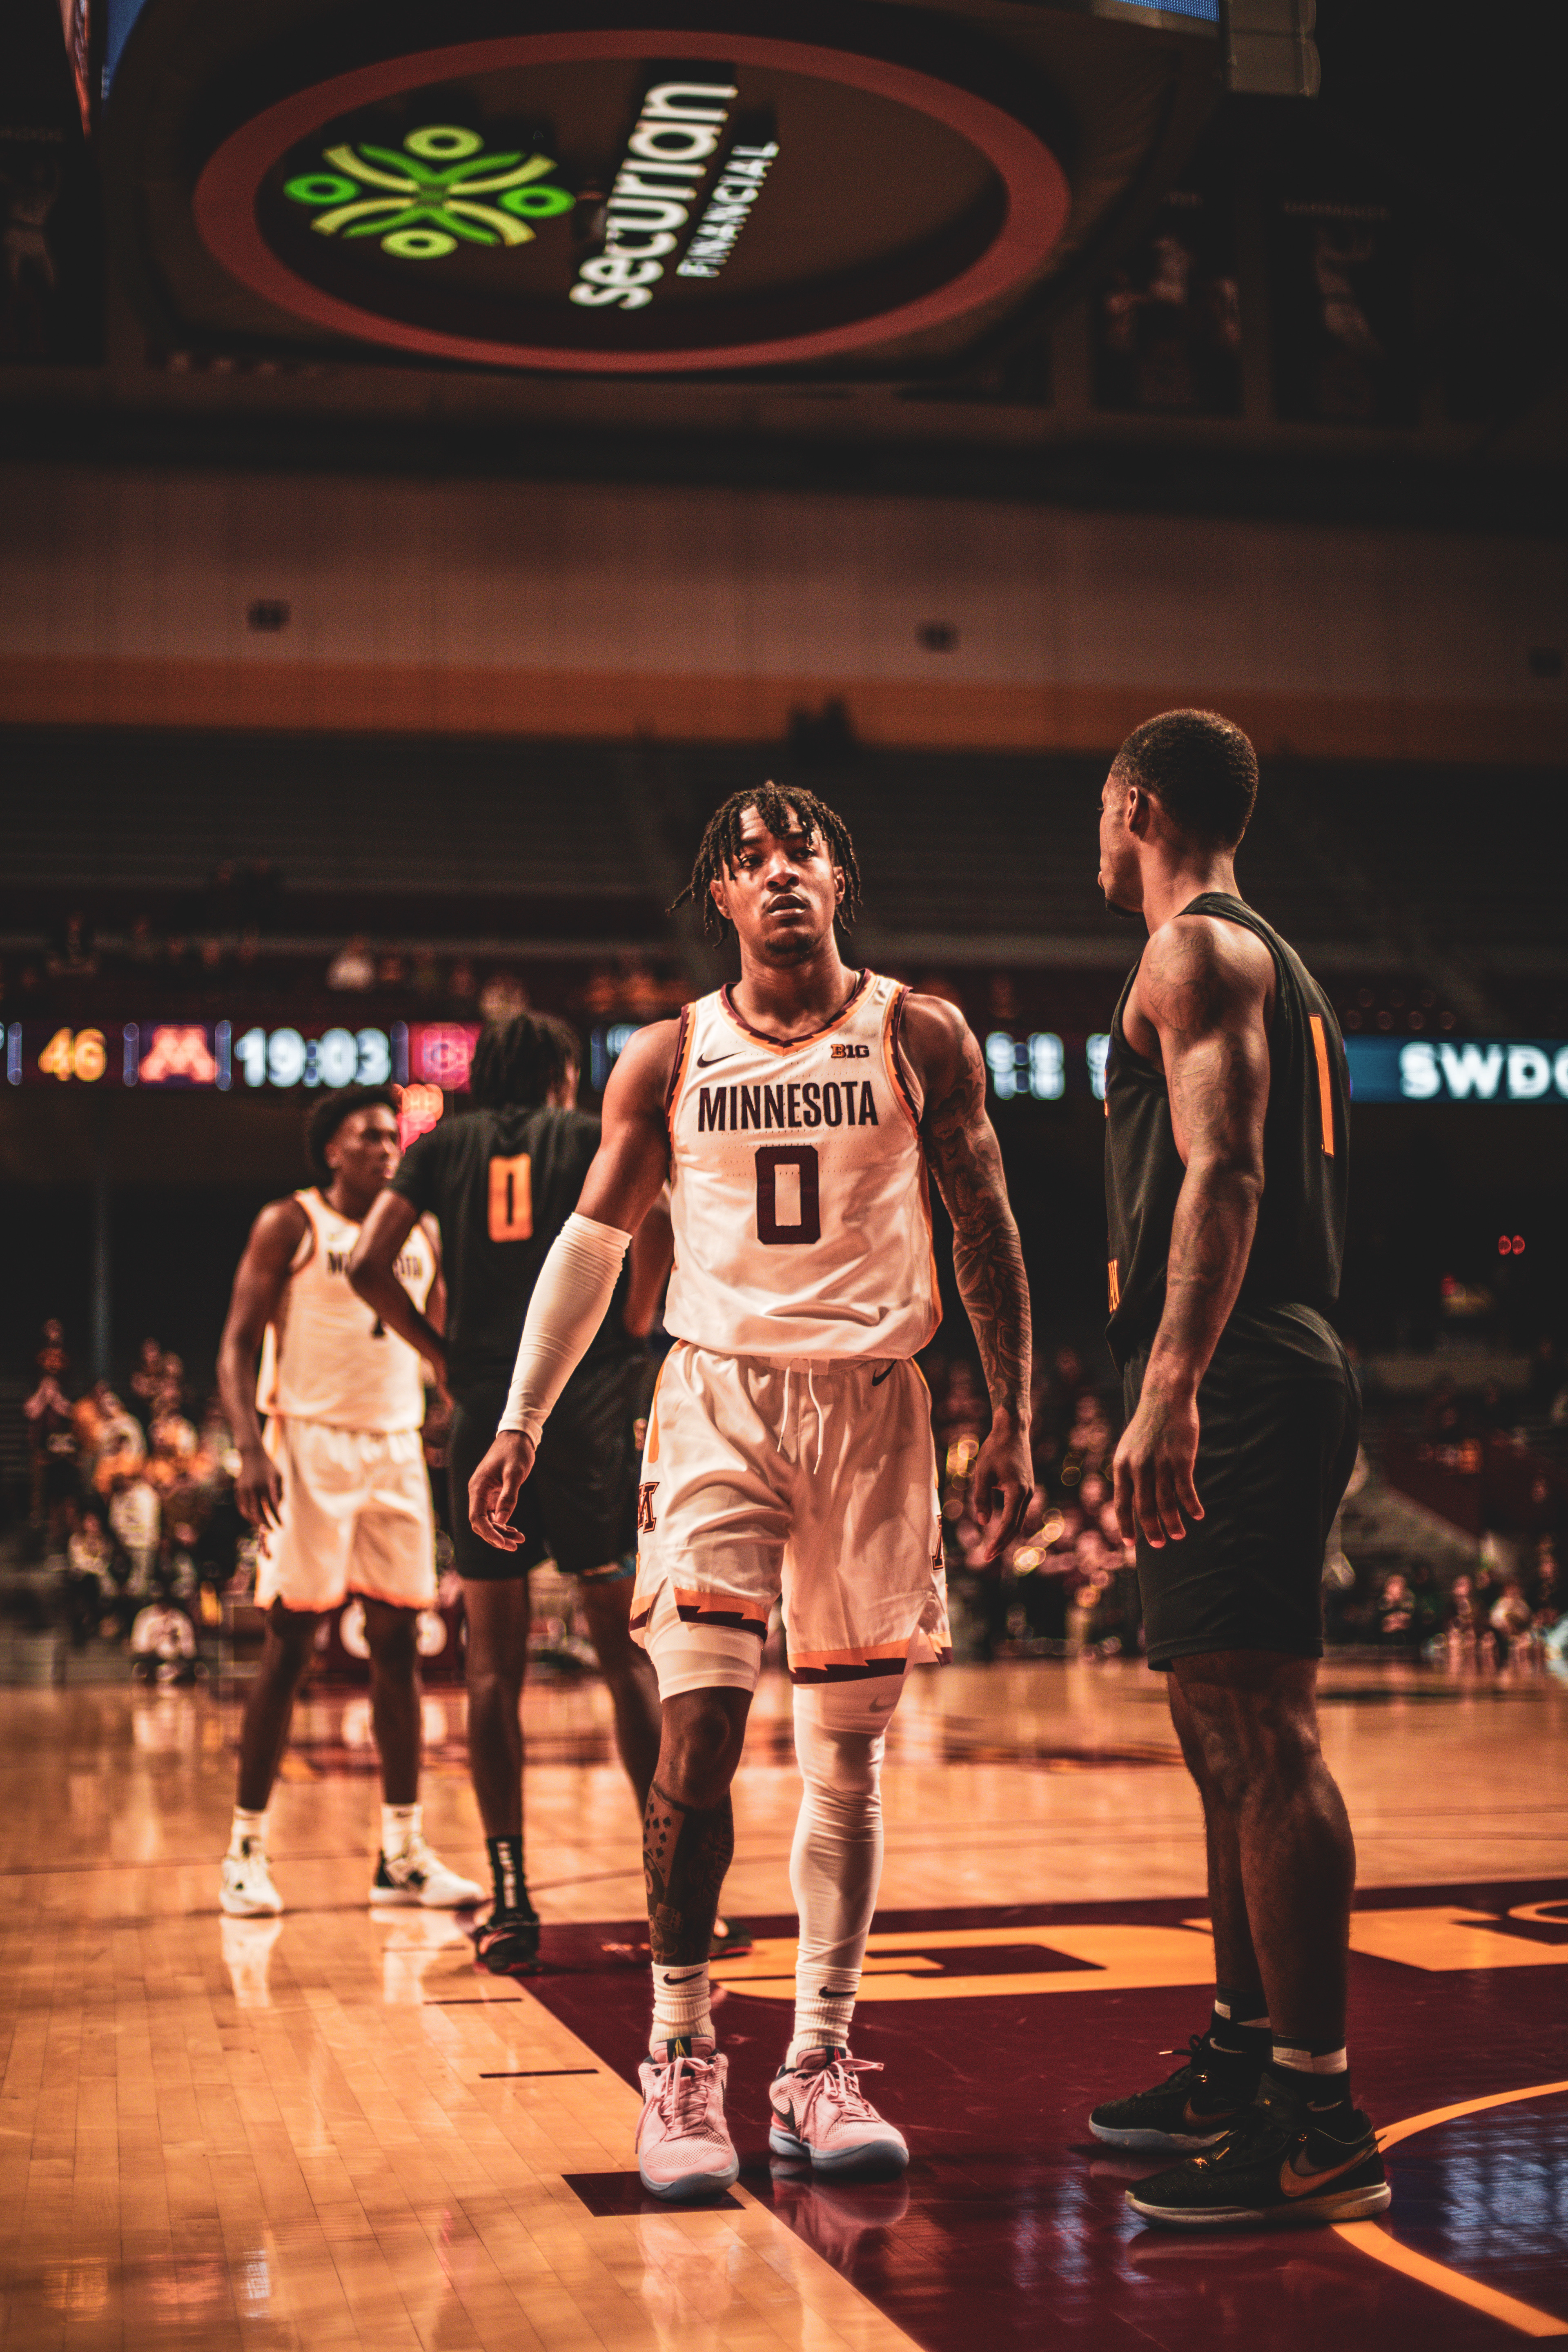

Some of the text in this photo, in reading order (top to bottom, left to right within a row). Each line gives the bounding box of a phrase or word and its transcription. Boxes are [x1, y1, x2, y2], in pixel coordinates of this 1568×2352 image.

[569, 81, 738, 310] securian
[675, 141, 780, 278] FINANCIAL
[38, 1027, 107, 1082] 46
[234, 1027, 391, 1088] 19:03
[698, 1081, 878, 1132] MINNESOTA
[488, 1152, 533, 1243] 0
[755, 1145, 821, 1245] 0
